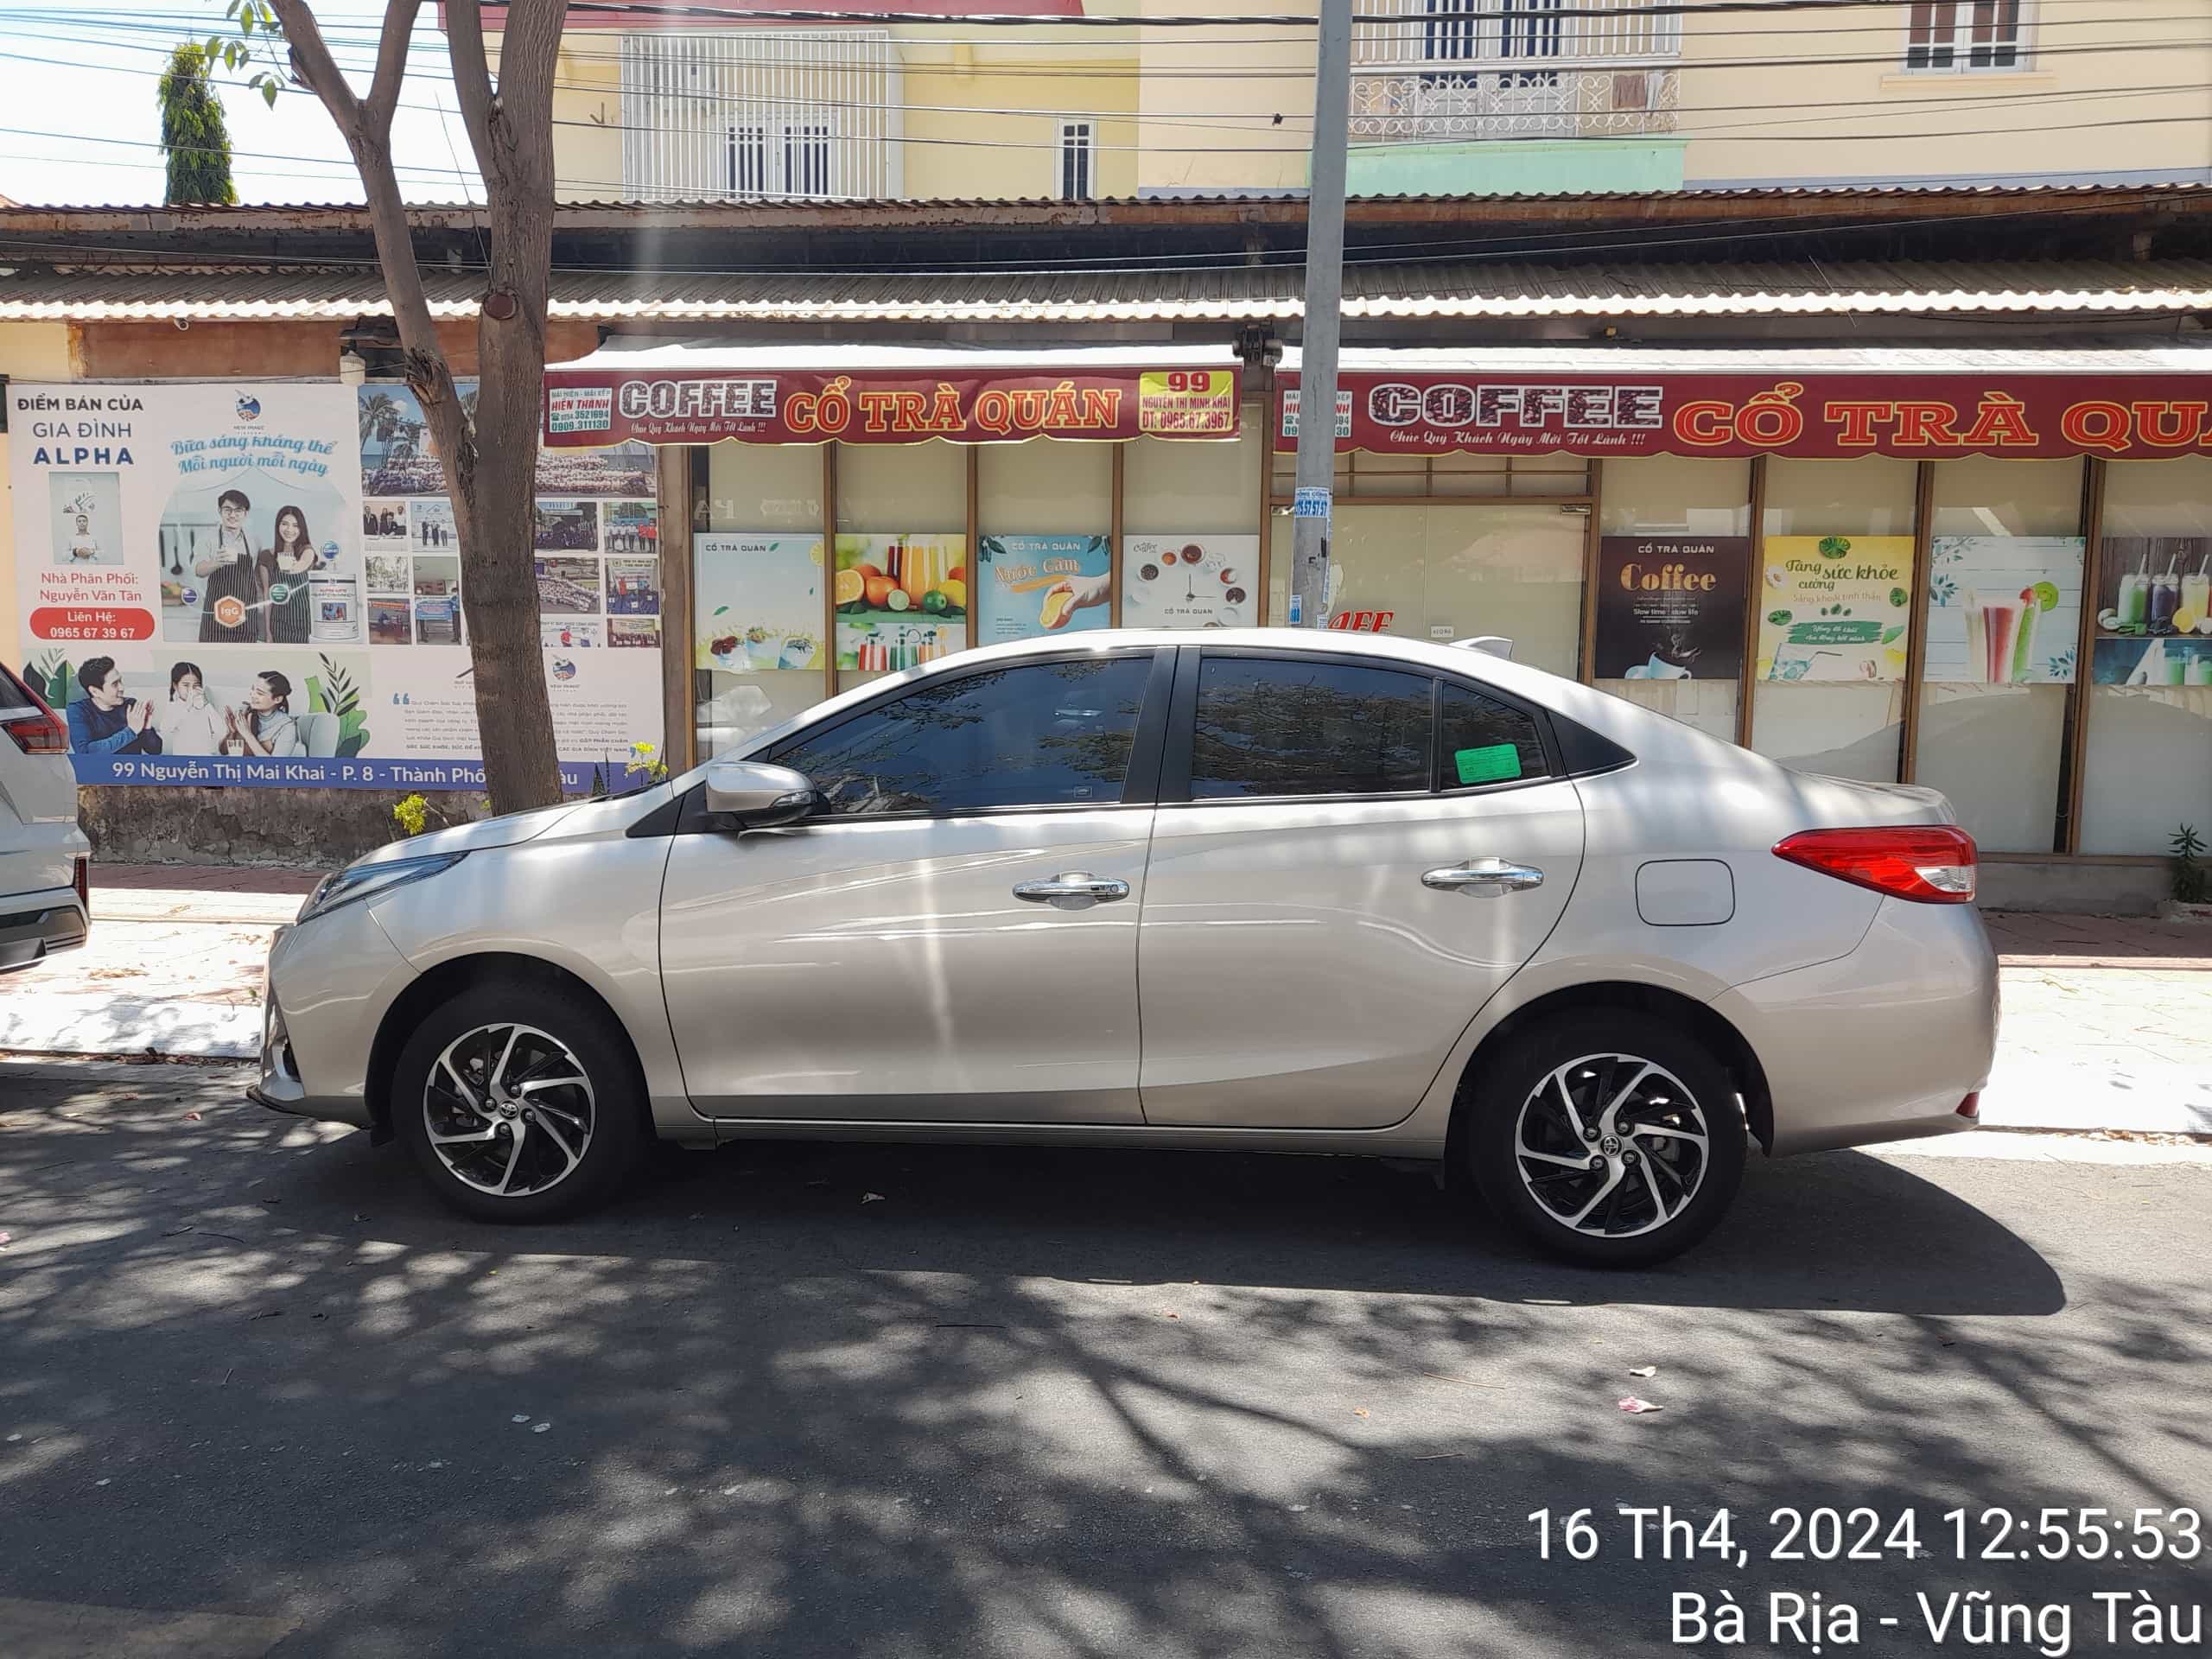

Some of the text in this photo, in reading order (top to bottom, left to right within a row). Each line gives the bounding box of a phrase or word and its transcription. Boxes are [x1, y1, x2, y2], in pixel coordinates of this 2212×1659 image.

[1168, 372, 1211, 392] 99
[17, 392, 143, 411] ĐIỂM BÁN CỦA
[620, 380, 778, 418] COFFEE
[784, 375, 1122, 435] CỔ TRÀ QUÁN
[1211, 396, 1230, 409] KHAI
[1369, 383, 1663, 429] COFFEE
[1674, 381, 2212, 452] CỔ TRÀ QU
[33, 417, 131, 438] GIA ĐÌNH
[1389, 429, 1419, 442] Chúc
[1451, 430, 1493, 444] Khách
[209, 434, 249, 450] sáng
[33, 447, 134, 465] ALPHA
[288, 458, 328, 477] ngày
[41, 571, 139, 585] Nhà Phân Phối:
[1620, 563, 1717, 592] Coffee
[40, 588, 89, 603] Nguyễn
[67, 611, 117, 625] Liên Hệ:
[220, 607, 238, 617] IgG
[50, 627, 135, 639] 0965 67 39 67
[112, 761, 135, 777] 99
[141, 760, 208, 781] Nguyễn
[213, 762, 241, 782] Thị
[247, 764, 279, 779] Mai
[286, 765, 325, 780] Khai
[342, 767, 357, 781] P.
[362, 767, 374, 782] 8
[390, 766, 446, 783] Thành
[559, 768, 578, 785] àu
